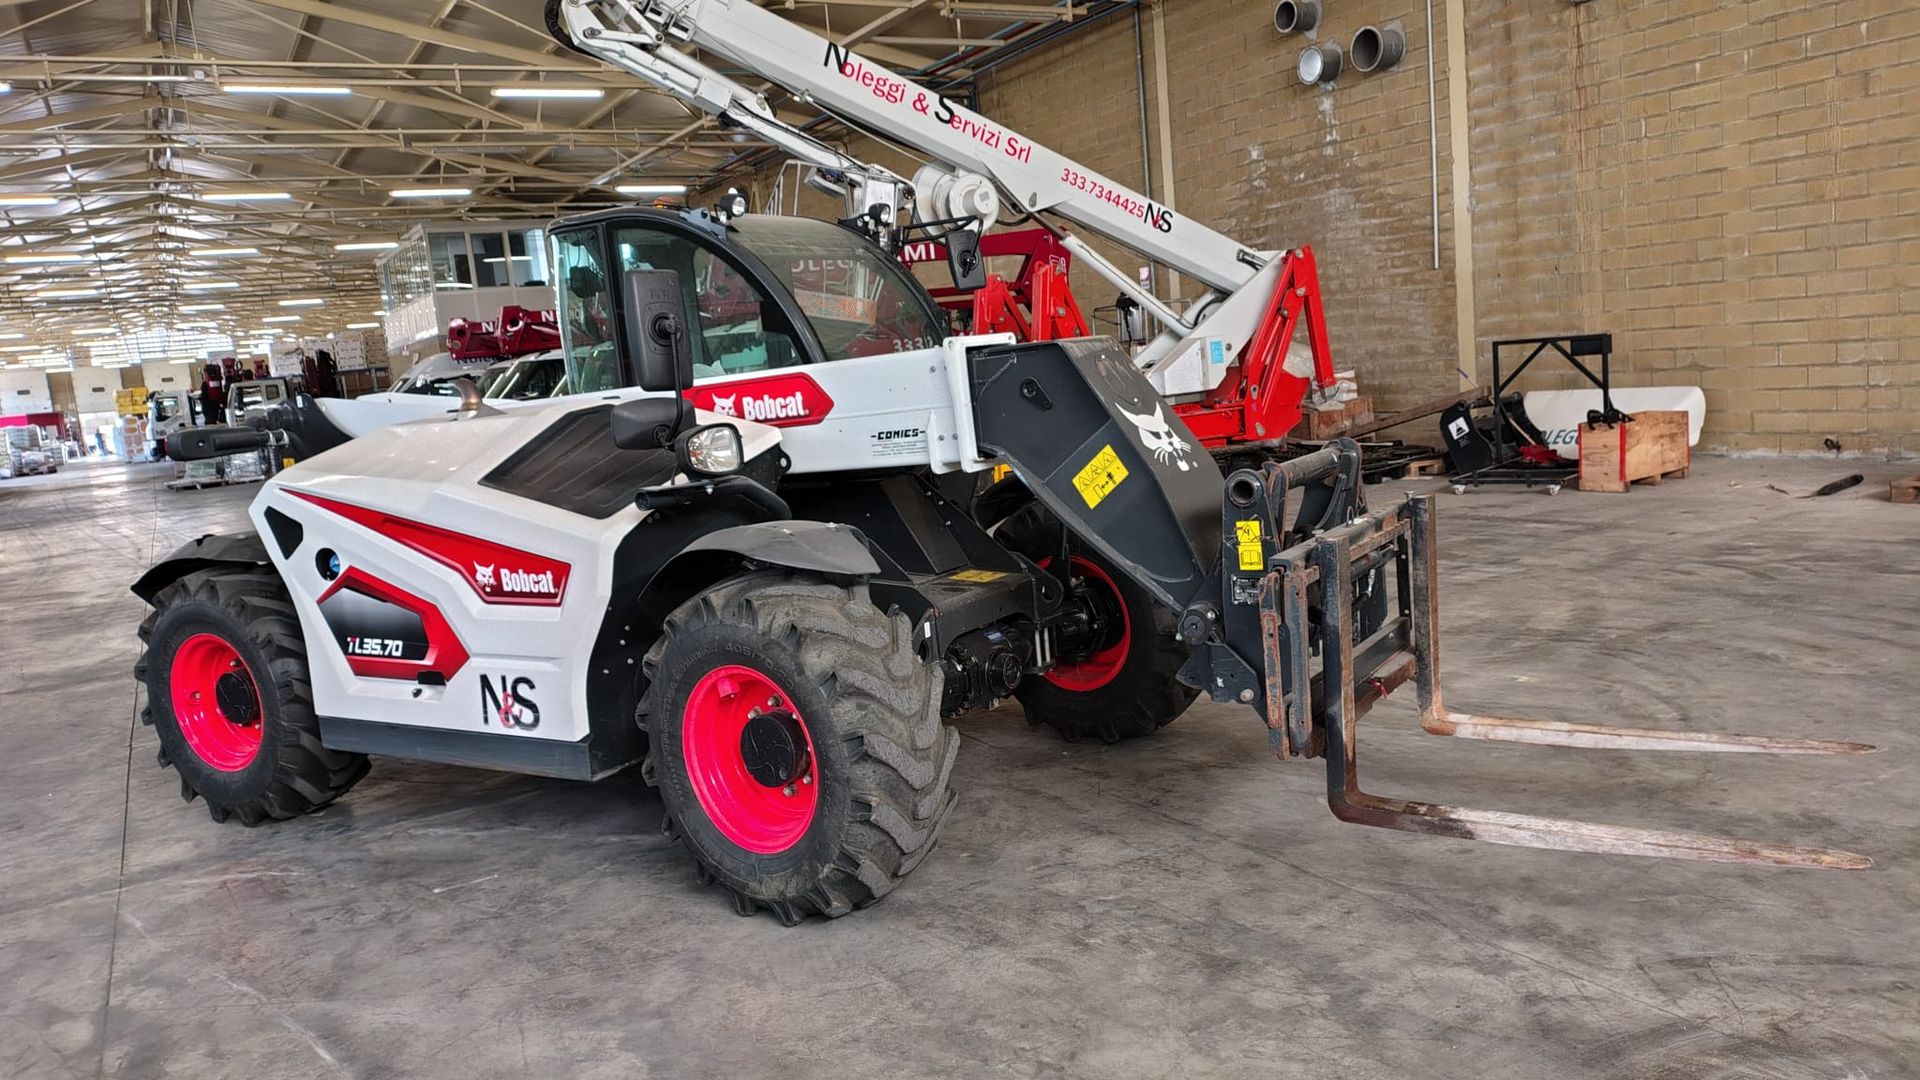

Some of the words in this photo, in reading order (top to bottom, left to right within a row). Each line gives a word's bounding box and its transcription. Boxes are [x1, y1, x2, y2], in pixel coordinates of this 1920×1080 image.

[823, 41, 906, 104] Noleggi
[912, 92, 929, 116] &
[934, 95, 1002, 149] Servizi
[1004, 137, 1032, 164] Srl
[1060, 168, 1145, 218] 333.7344425
[742, 391, 805, 420] Bobcat
[499, 567, 555, 594] Bobcat
